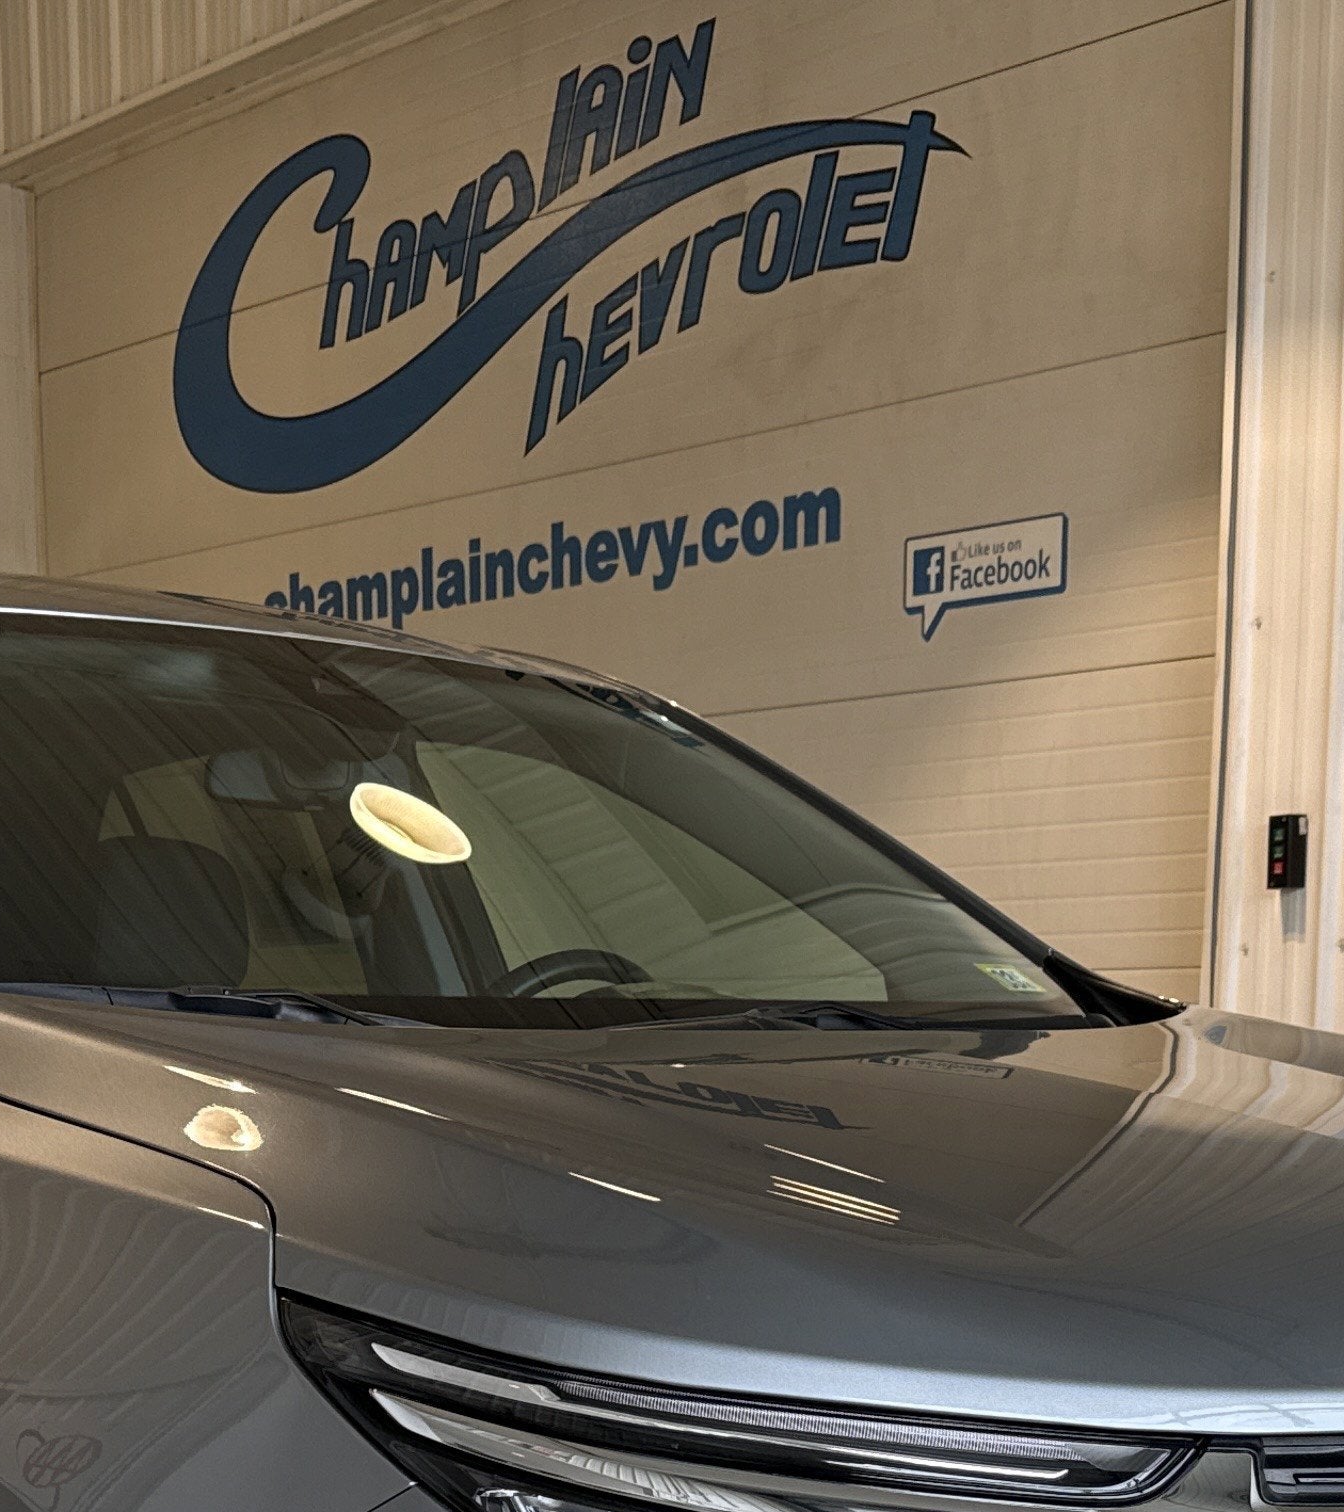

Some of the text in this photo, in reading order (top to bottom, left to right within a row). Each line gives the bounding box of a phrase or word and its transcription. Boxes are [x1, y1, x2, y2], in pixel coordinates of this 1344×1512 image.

[968, 539, 1022, 559] Like us on
[949, 548, 1051, 592] Facebook
